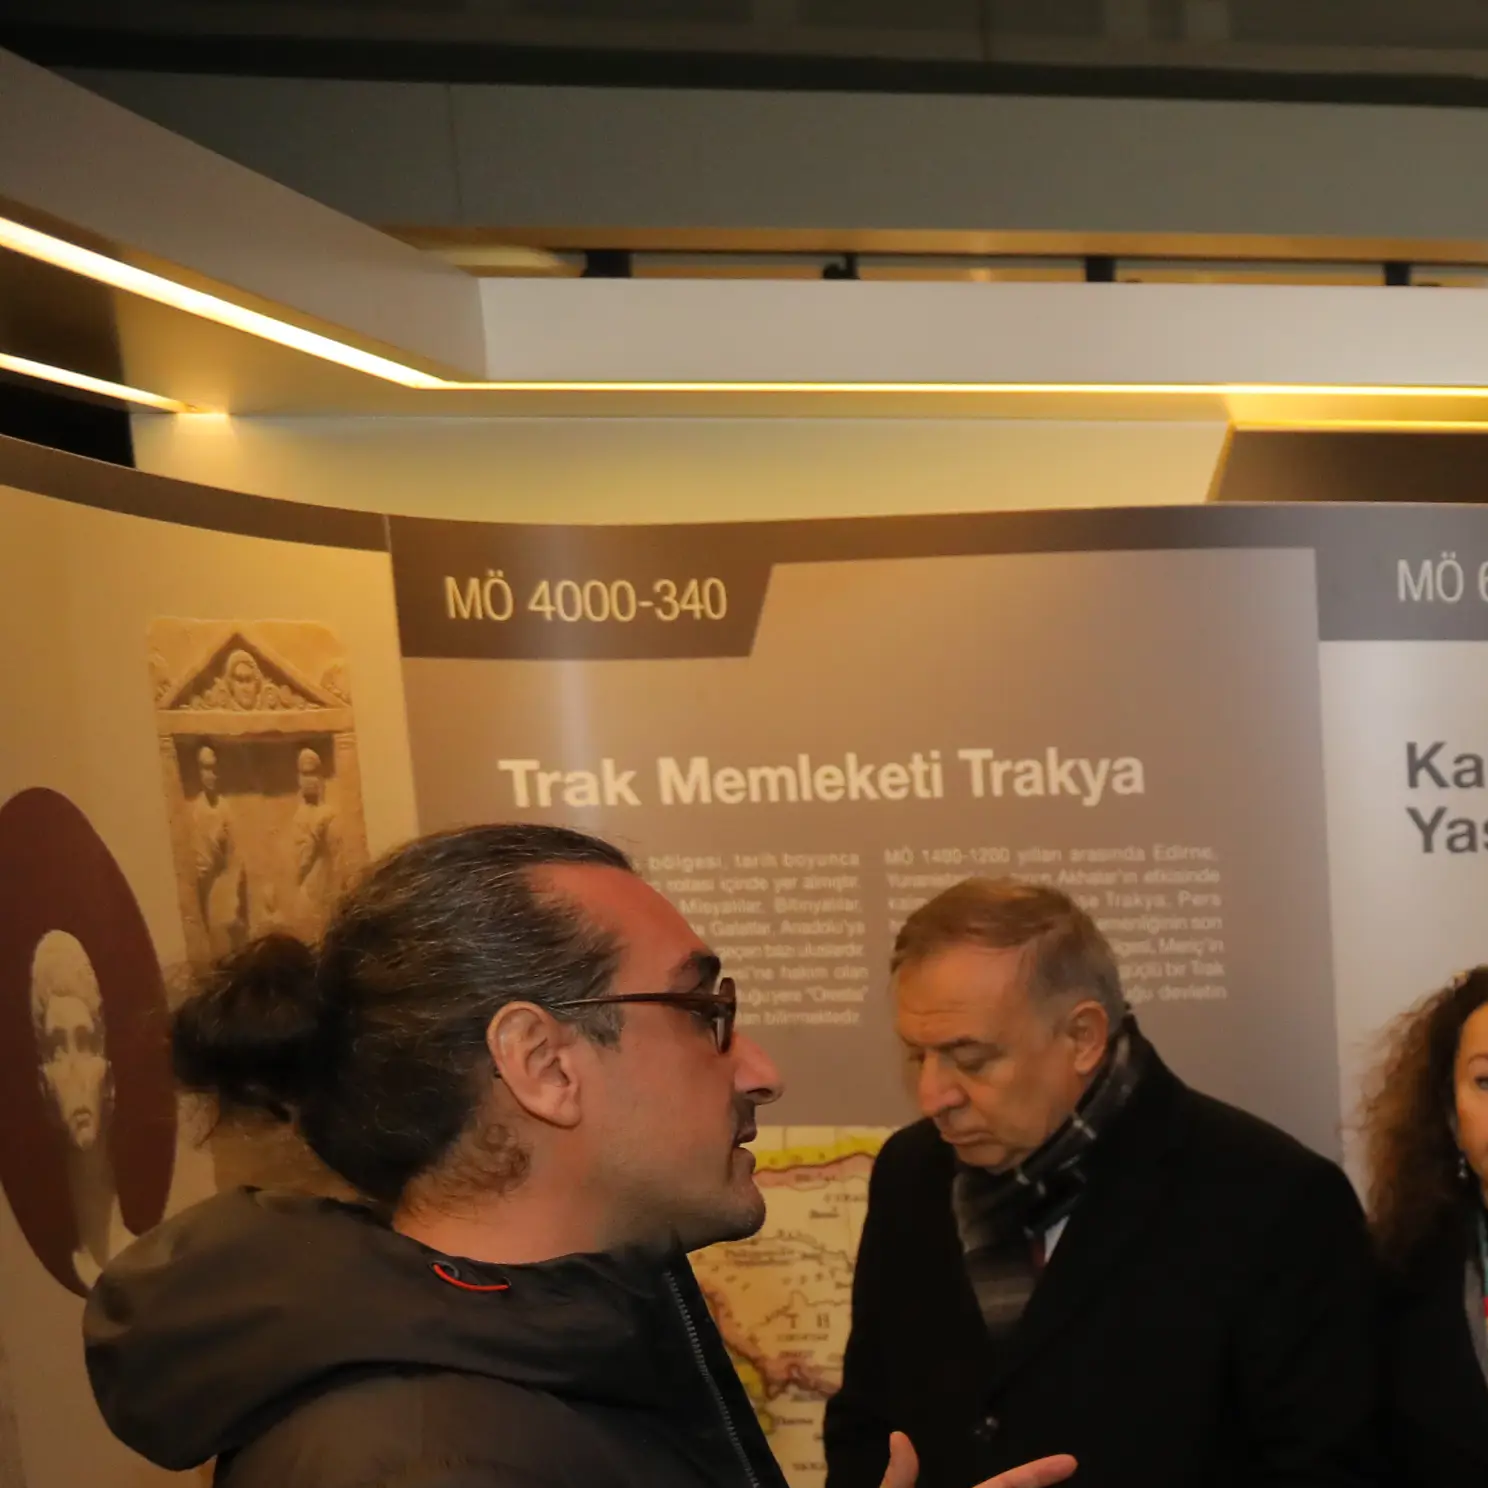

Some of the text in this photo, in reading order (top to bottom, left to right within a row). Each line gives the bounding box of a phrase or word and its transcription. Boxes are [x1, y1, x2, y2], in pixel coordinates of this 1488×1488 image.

[444, 571, 728, 623] MÖ 4000-340
[1397, 552, 1464, 603] MÖ
[498, 746, 1145, 808] Trak Memleketi Trakya
